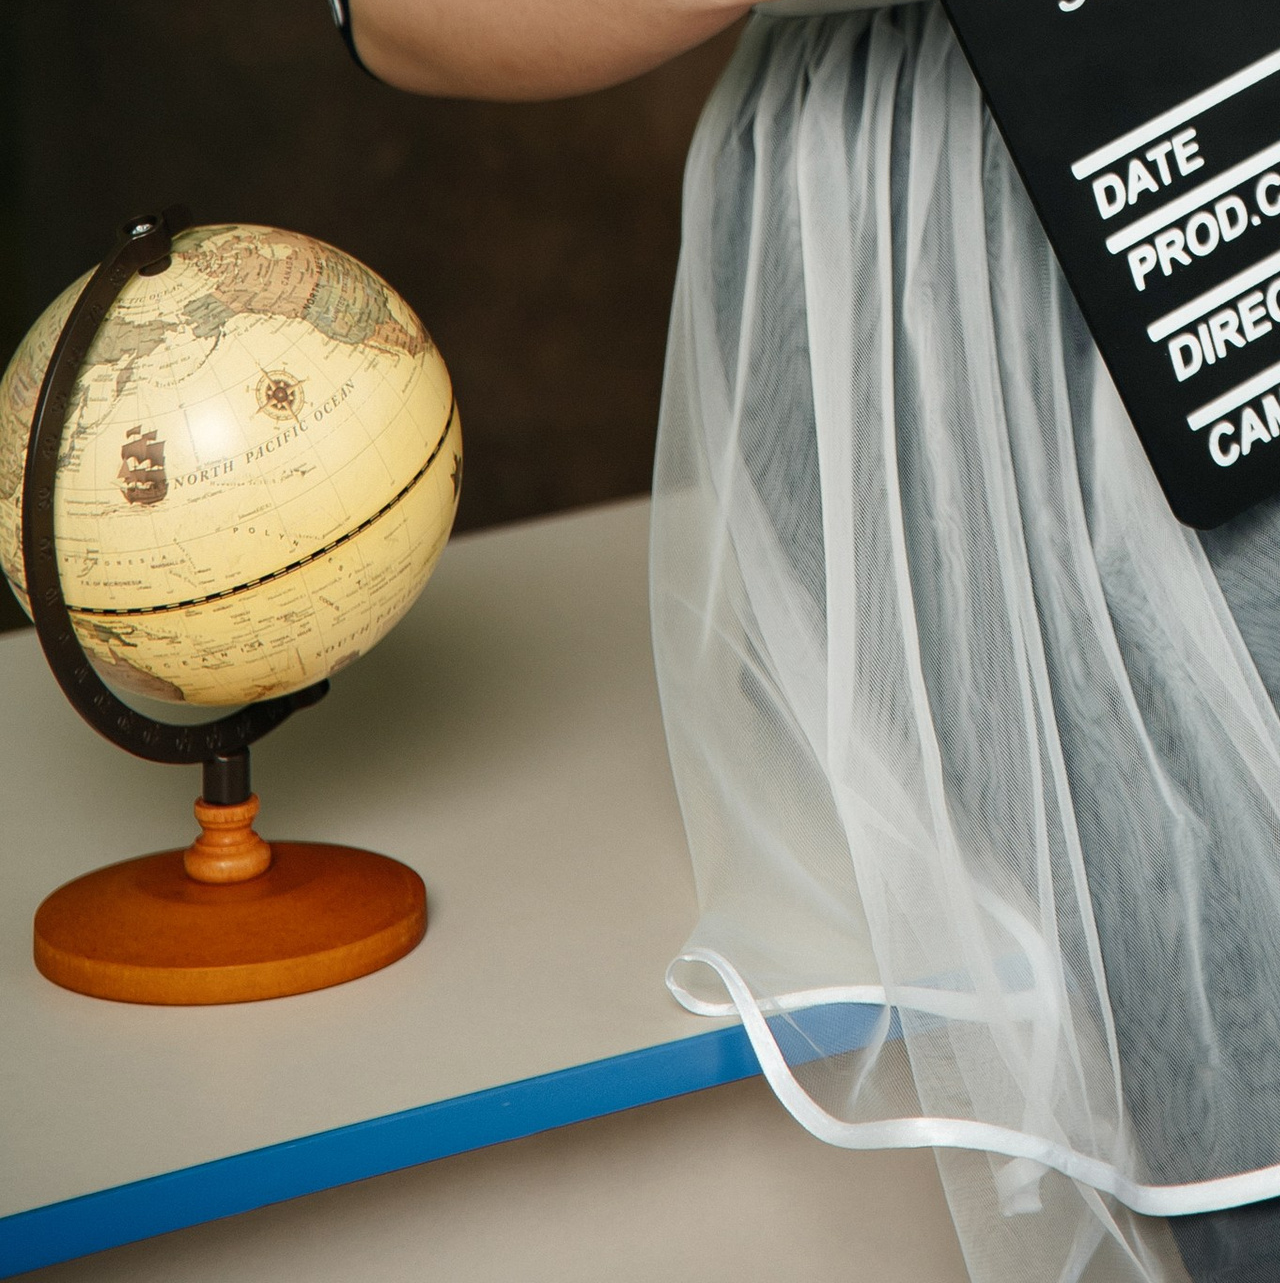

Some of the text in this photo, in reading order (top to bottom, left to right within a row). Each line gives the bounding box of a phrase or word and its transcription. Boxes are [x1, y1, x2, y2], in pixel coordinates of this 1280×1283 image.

[1091, 127, 1205, 220] DATE
[173, 460, 235, 490] NORTH
[245, 420, 308, 465] PACIFIC
[313, 379, 356, 423] OCEAN
